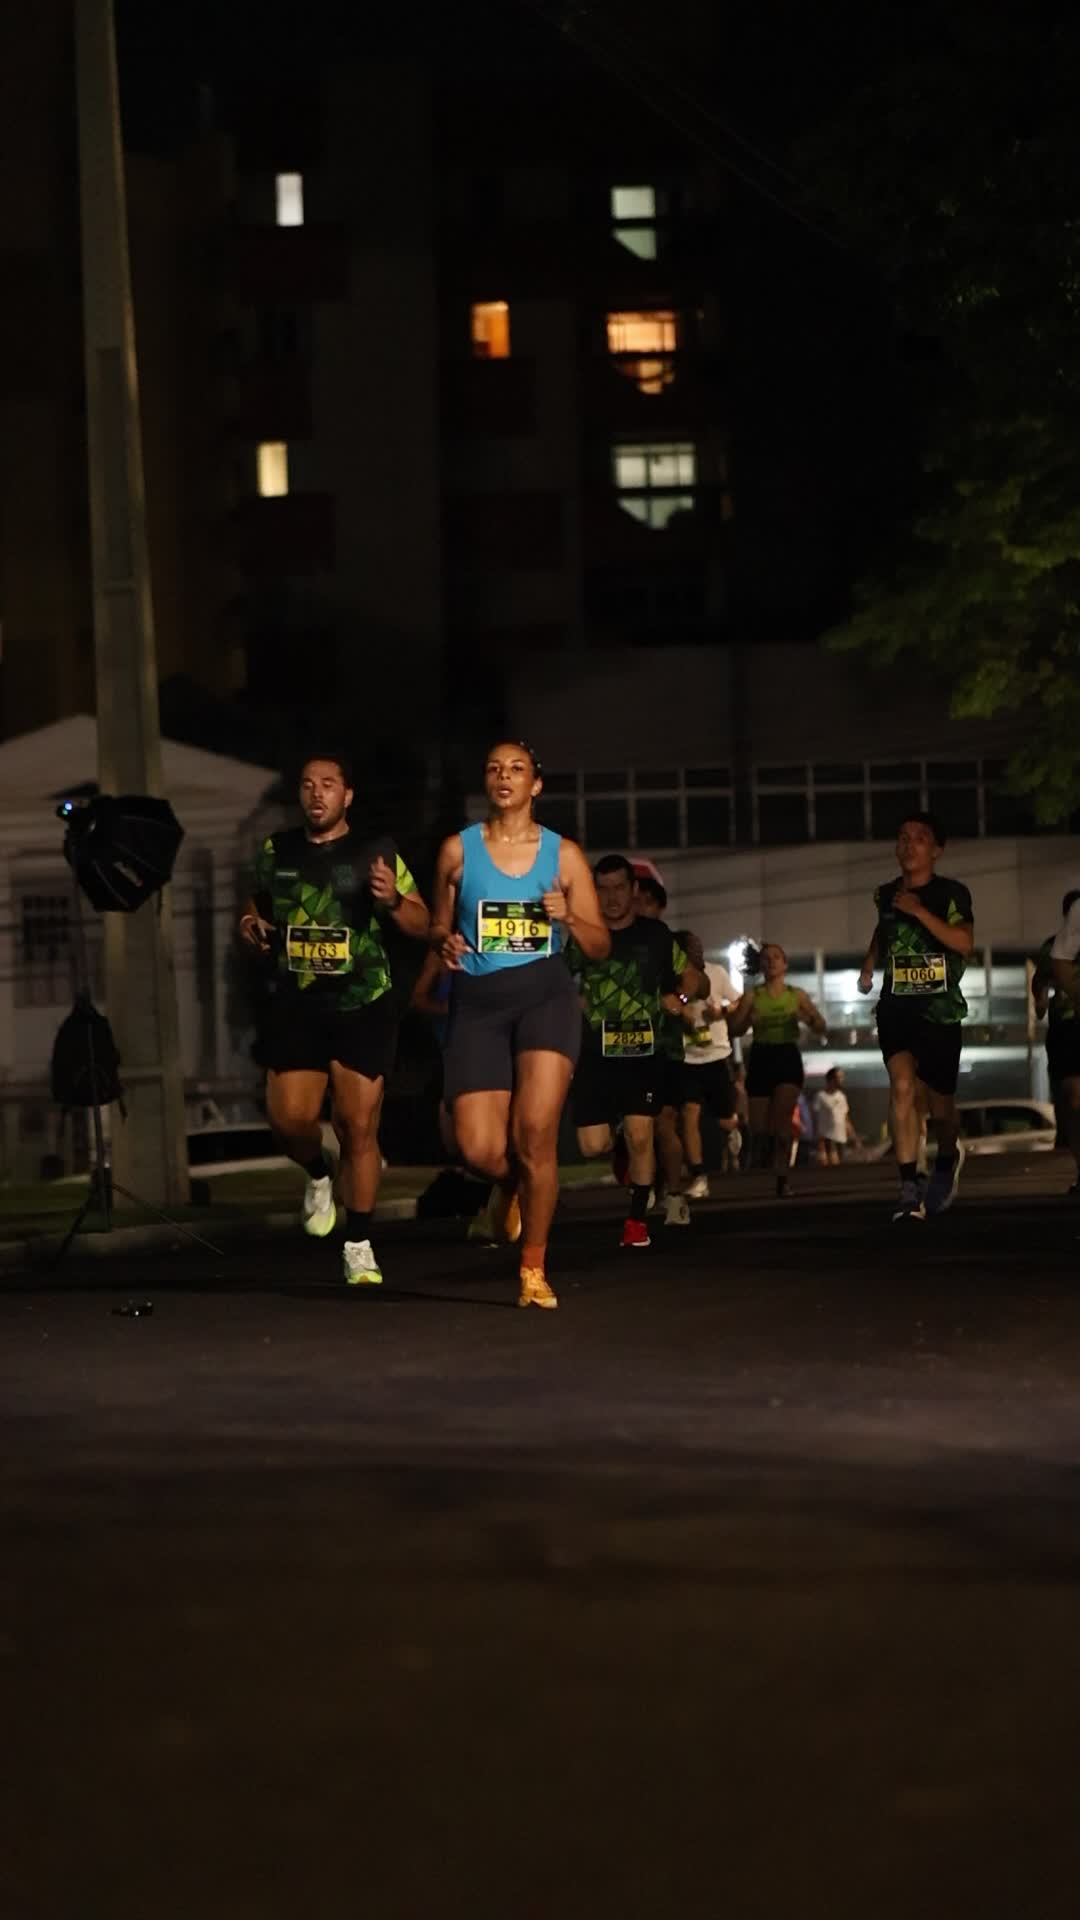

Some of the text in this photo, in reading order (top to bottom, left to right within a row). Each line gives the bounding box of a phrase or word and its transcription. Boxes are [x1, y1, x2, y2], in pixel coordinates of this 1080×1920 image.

[495, 920, 540, 936] 1916
[300, 943, 336, 958] 1763
[902, 968, 936, 982] 1060
[613, 1032, 645, 1044] 2823
